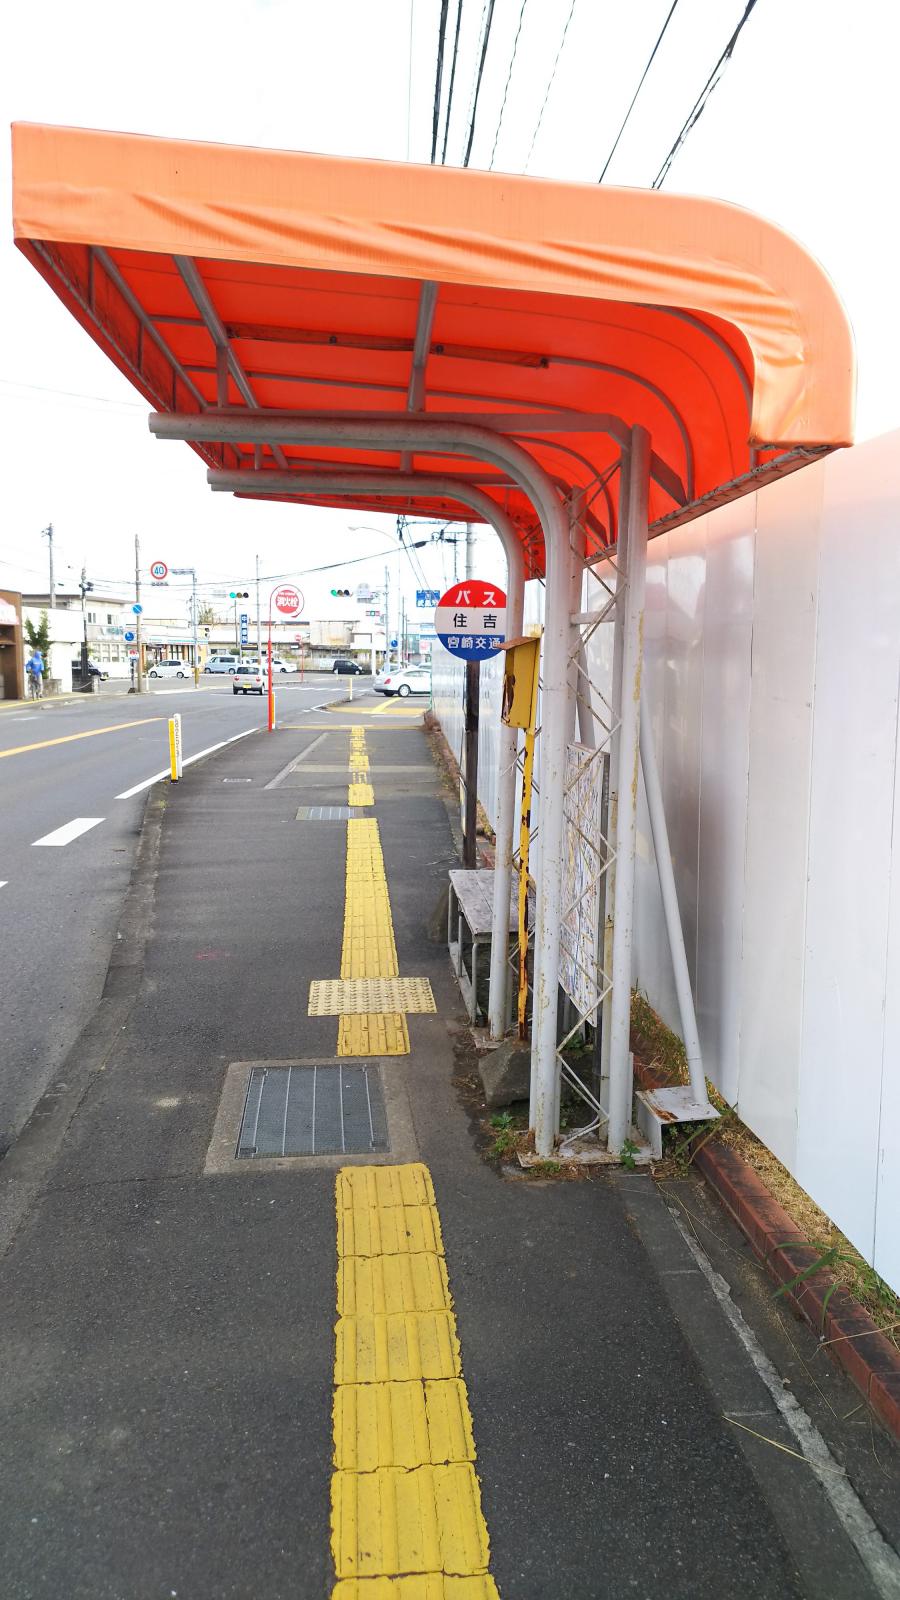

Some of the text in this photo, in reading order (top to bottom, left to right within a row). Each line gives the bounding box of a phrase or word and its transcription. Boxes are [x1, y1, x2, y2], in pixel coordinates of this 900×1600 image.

[154, 565, 164, 575] 40
[277, 597, 298, 607] 消火栓
[455, 590, 497, 605] バス
[453, 613, 497, 628] 住吉
[447, 636, 501, 649] 宮崎交通
